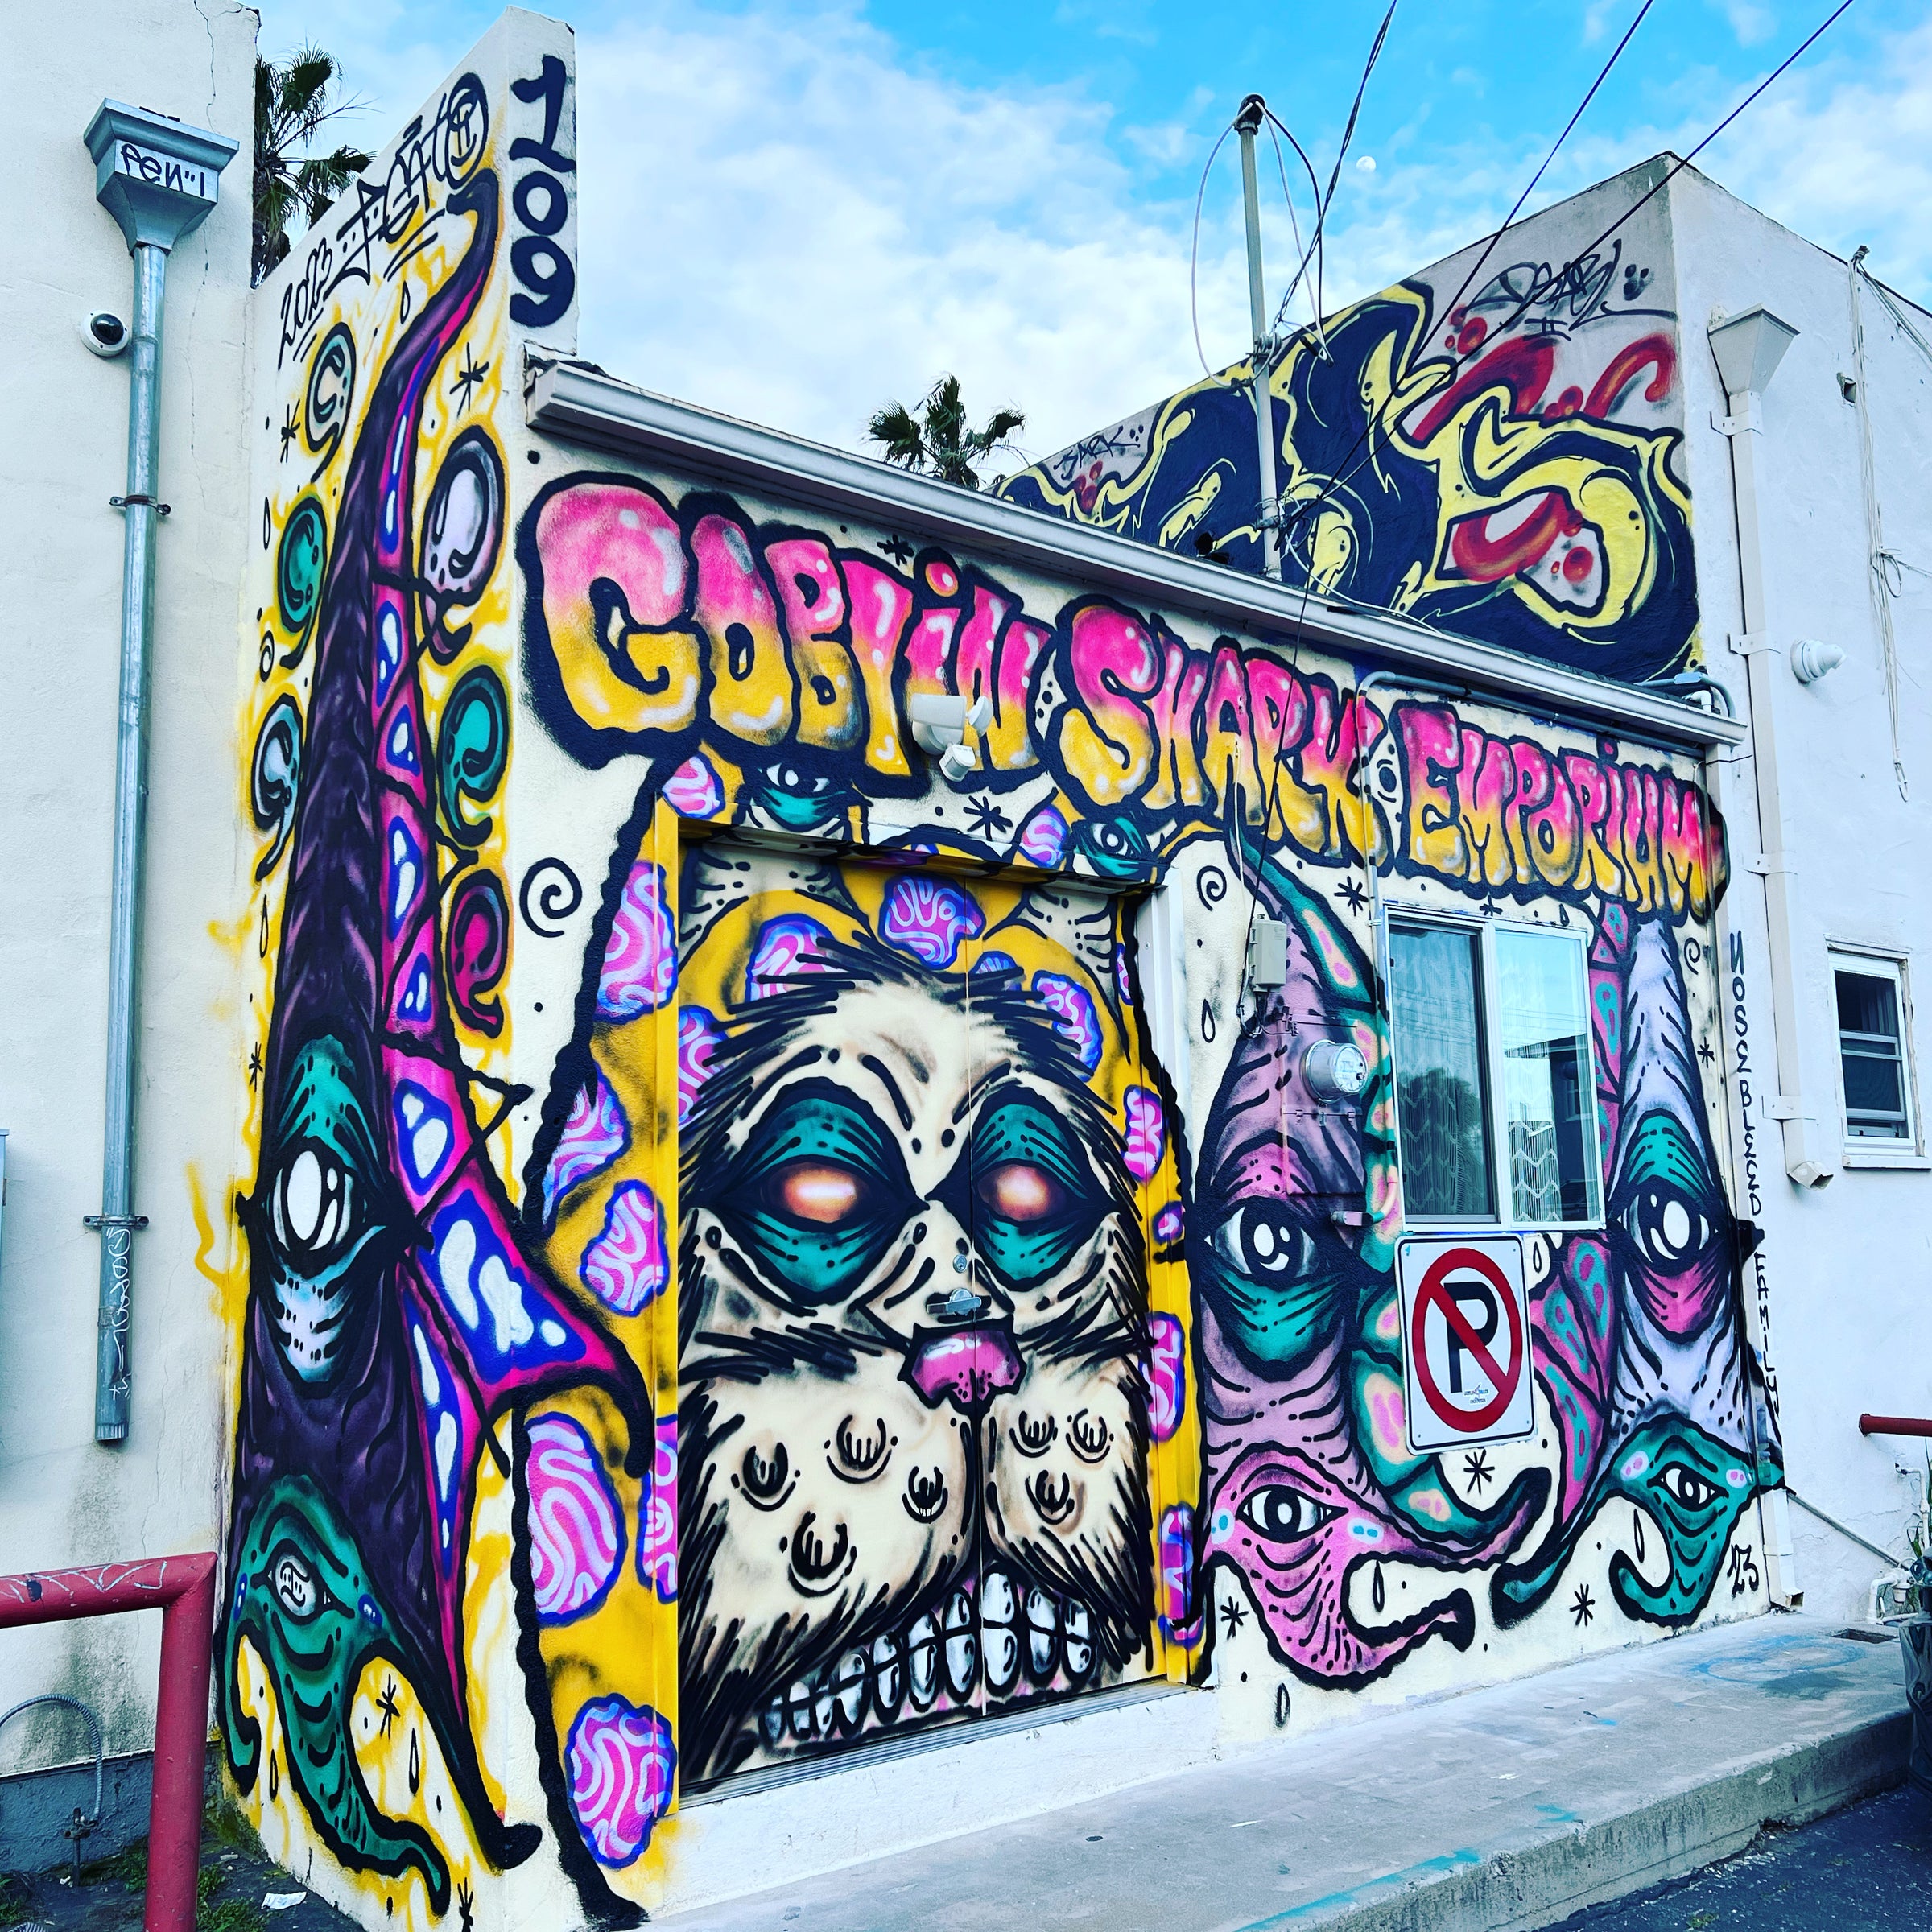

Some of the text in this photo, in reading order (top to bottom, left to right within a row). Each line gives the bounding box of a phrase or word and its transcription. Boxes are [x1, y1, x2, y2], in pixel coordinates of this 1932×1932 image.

[509, 55, 577, 328] 109
[1053, 594, 1386, 876] SHARK
[1730, 930, 1763, 1216] NOSEBLEED
